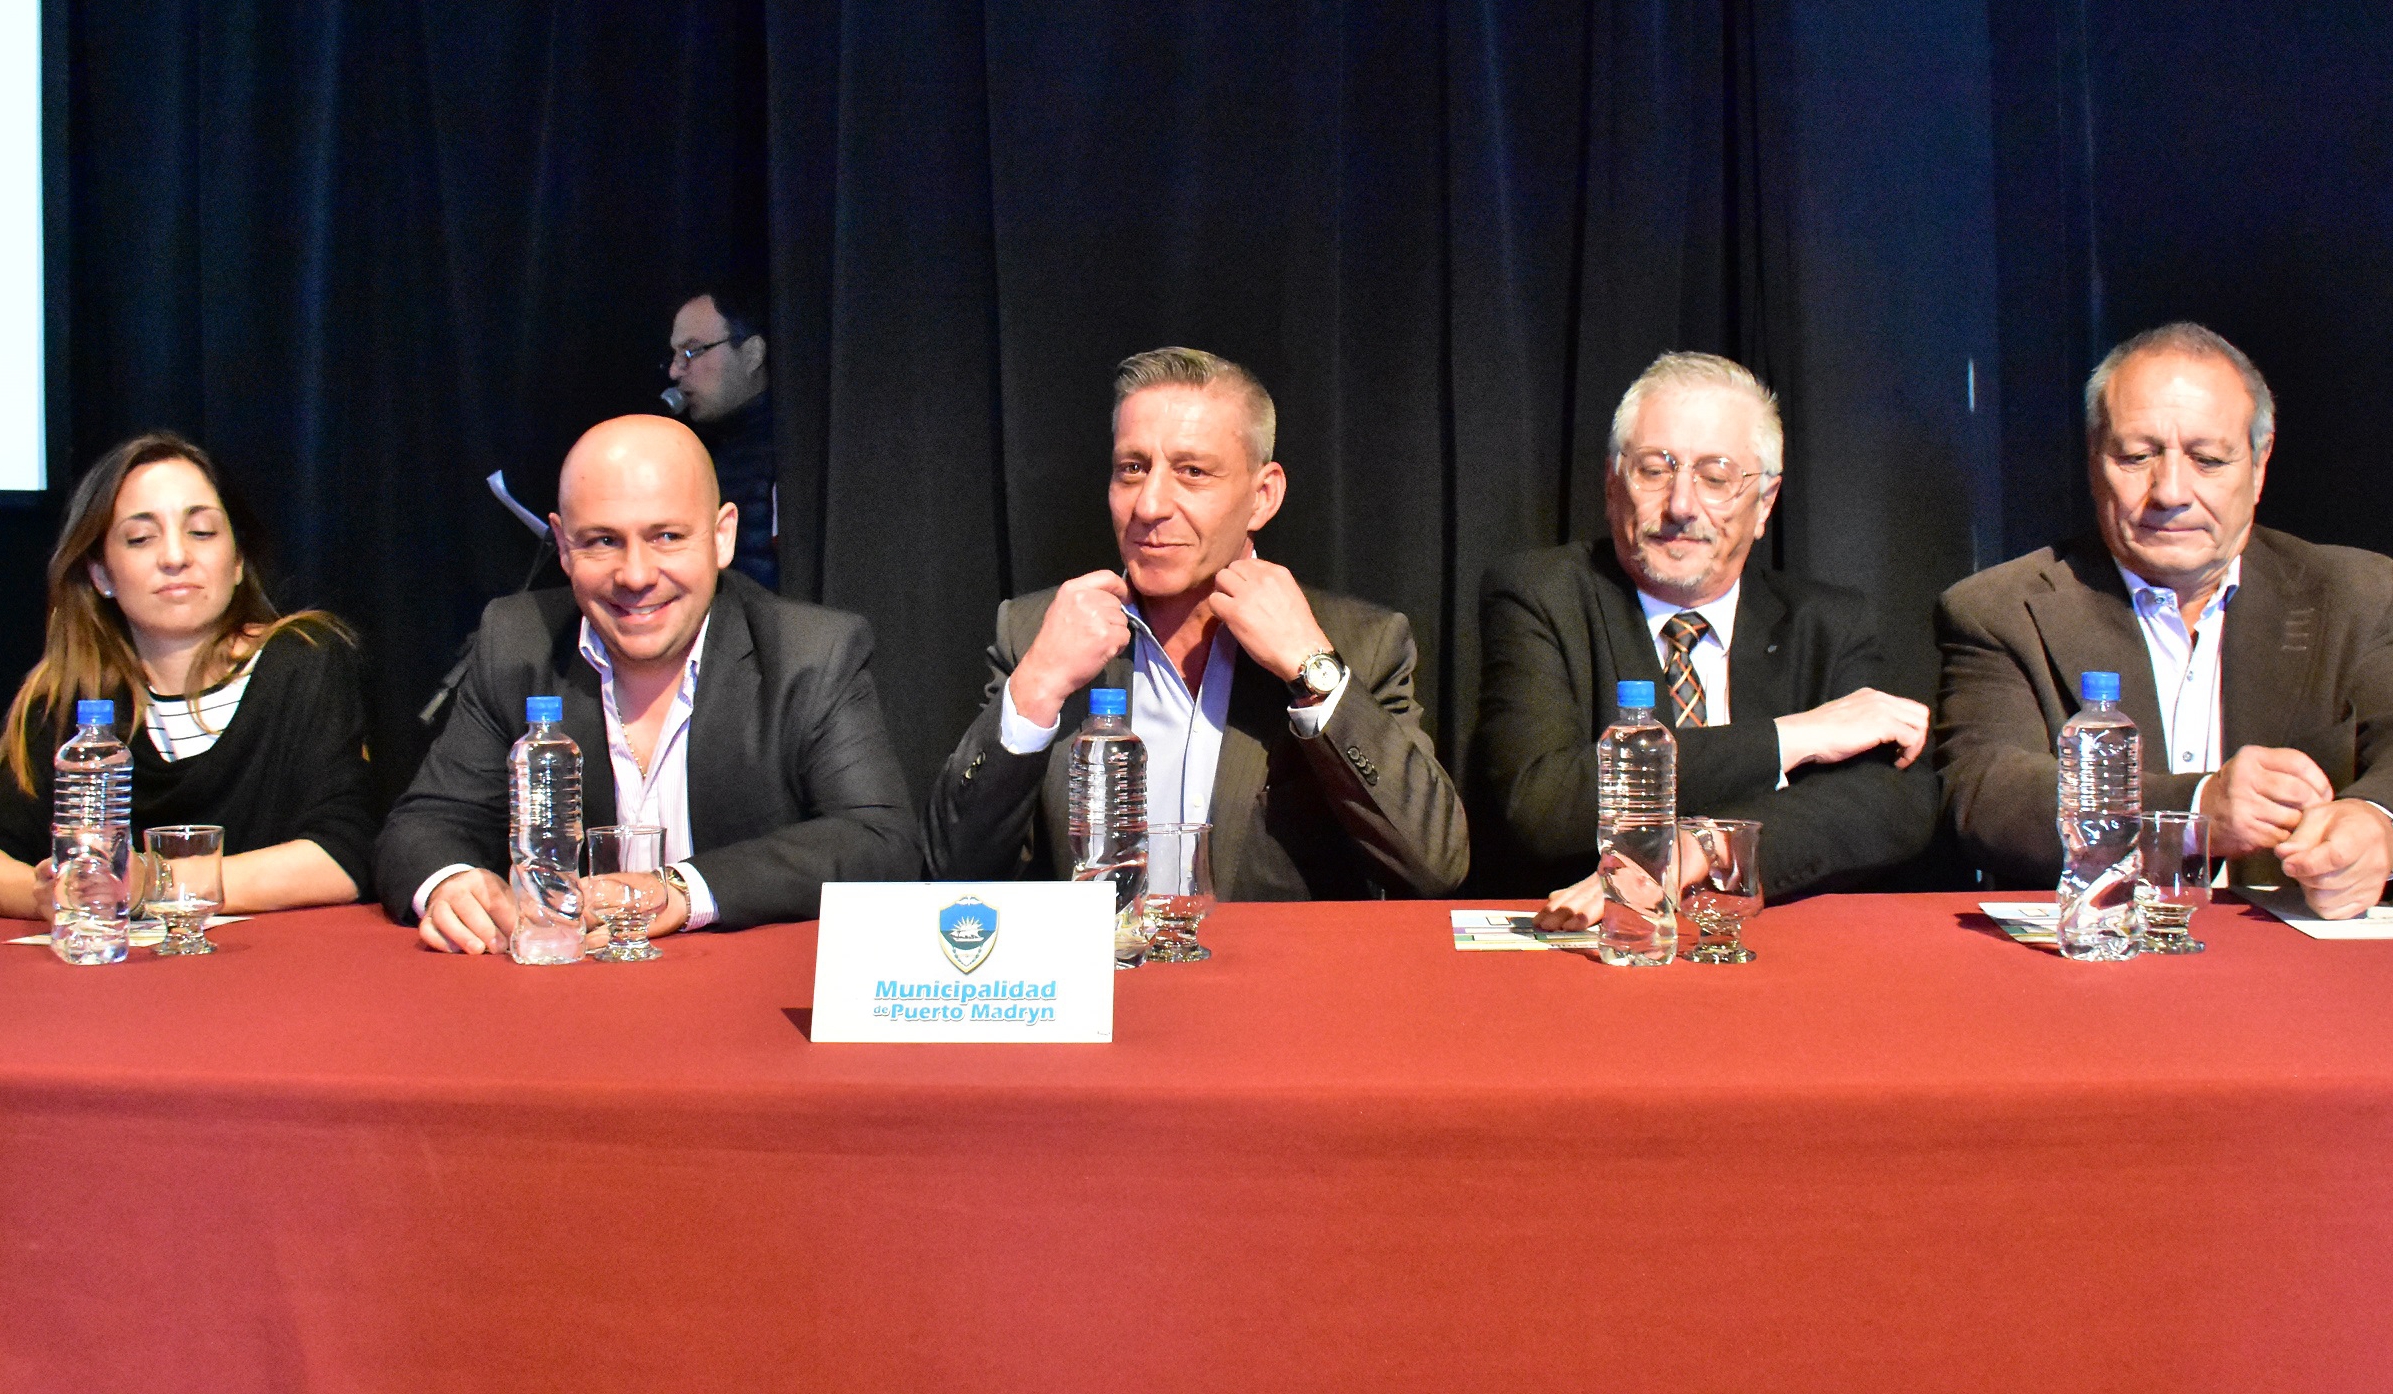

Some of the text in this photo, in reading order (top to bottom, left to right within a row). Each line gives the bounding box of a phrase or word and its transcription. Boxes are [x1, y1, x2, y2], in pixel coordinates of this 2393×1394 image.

[875, 980, 1057, 1003] Municipalidad
[873, 1004, 1055, 1023] de Puerto Madryn
